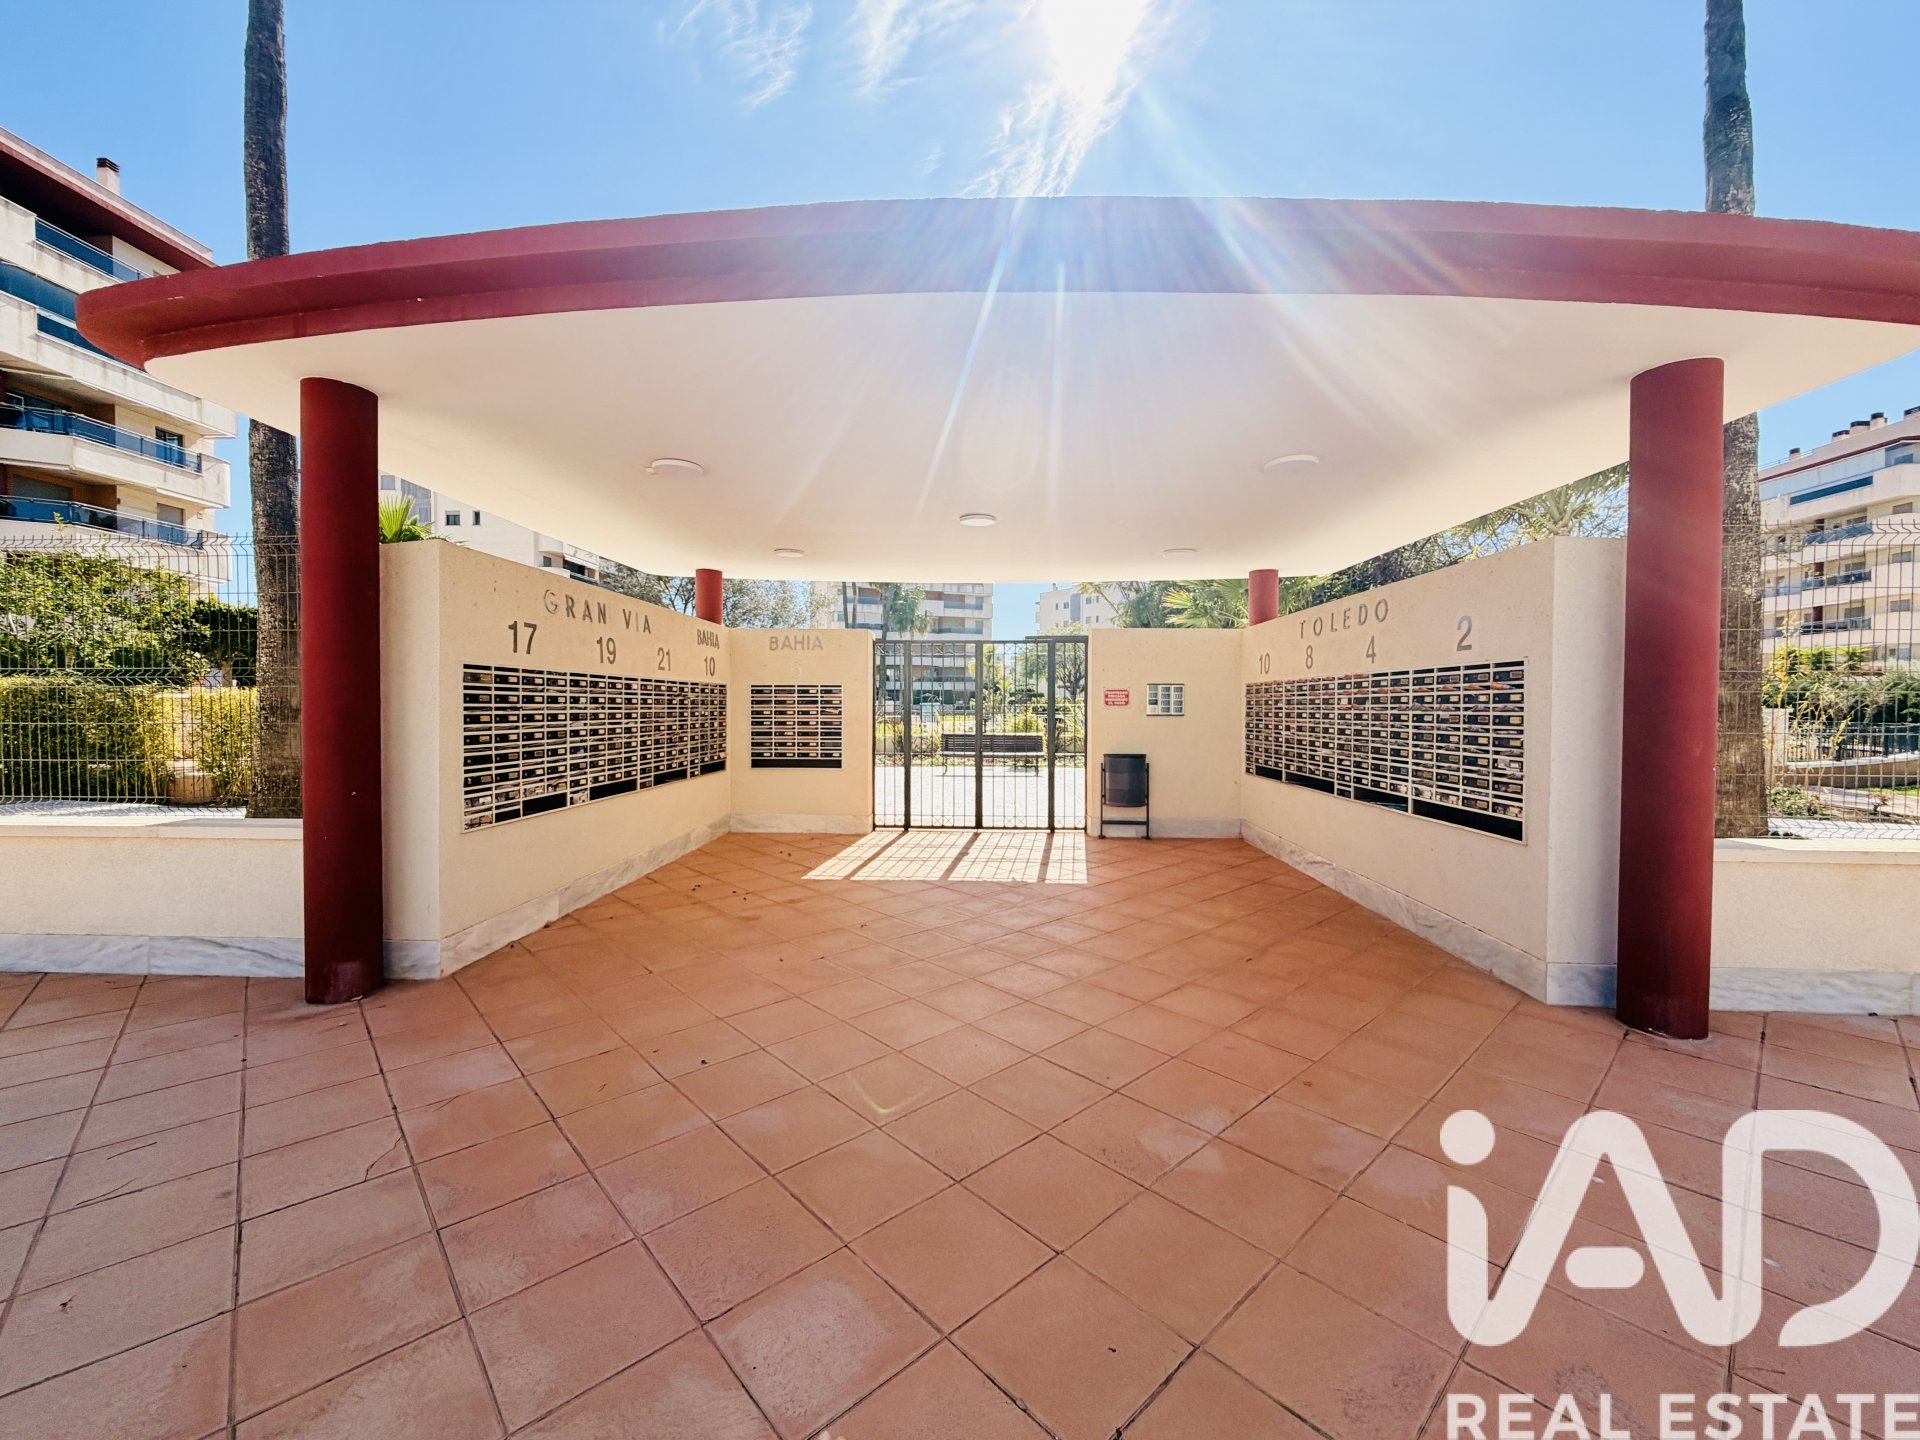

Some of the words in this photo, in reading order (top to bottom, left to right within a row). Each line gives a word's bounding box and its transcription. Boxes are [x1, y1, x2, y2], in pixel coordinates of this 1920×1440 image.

[543, 588, 607, 625] GRAN
[622, 608, 652, 635] VIA
[1299, 598, 1389, 640] TOLEDO
[507, 620, 537, 655] 17
[696, 628, 720, 650] BAHIA
[769, 635, 823, 651] BAHIA
[1456, 615, 1473, 652] 2
[596, 636, 617, 665] 19
[657, 647, 672, 672] 21
[1305, 644, 1314, 670] 8
[1365, 635, 1377, 664] 4
[703, 656, 716, 678] 10
[1258, 652, 1271, 675] 10
